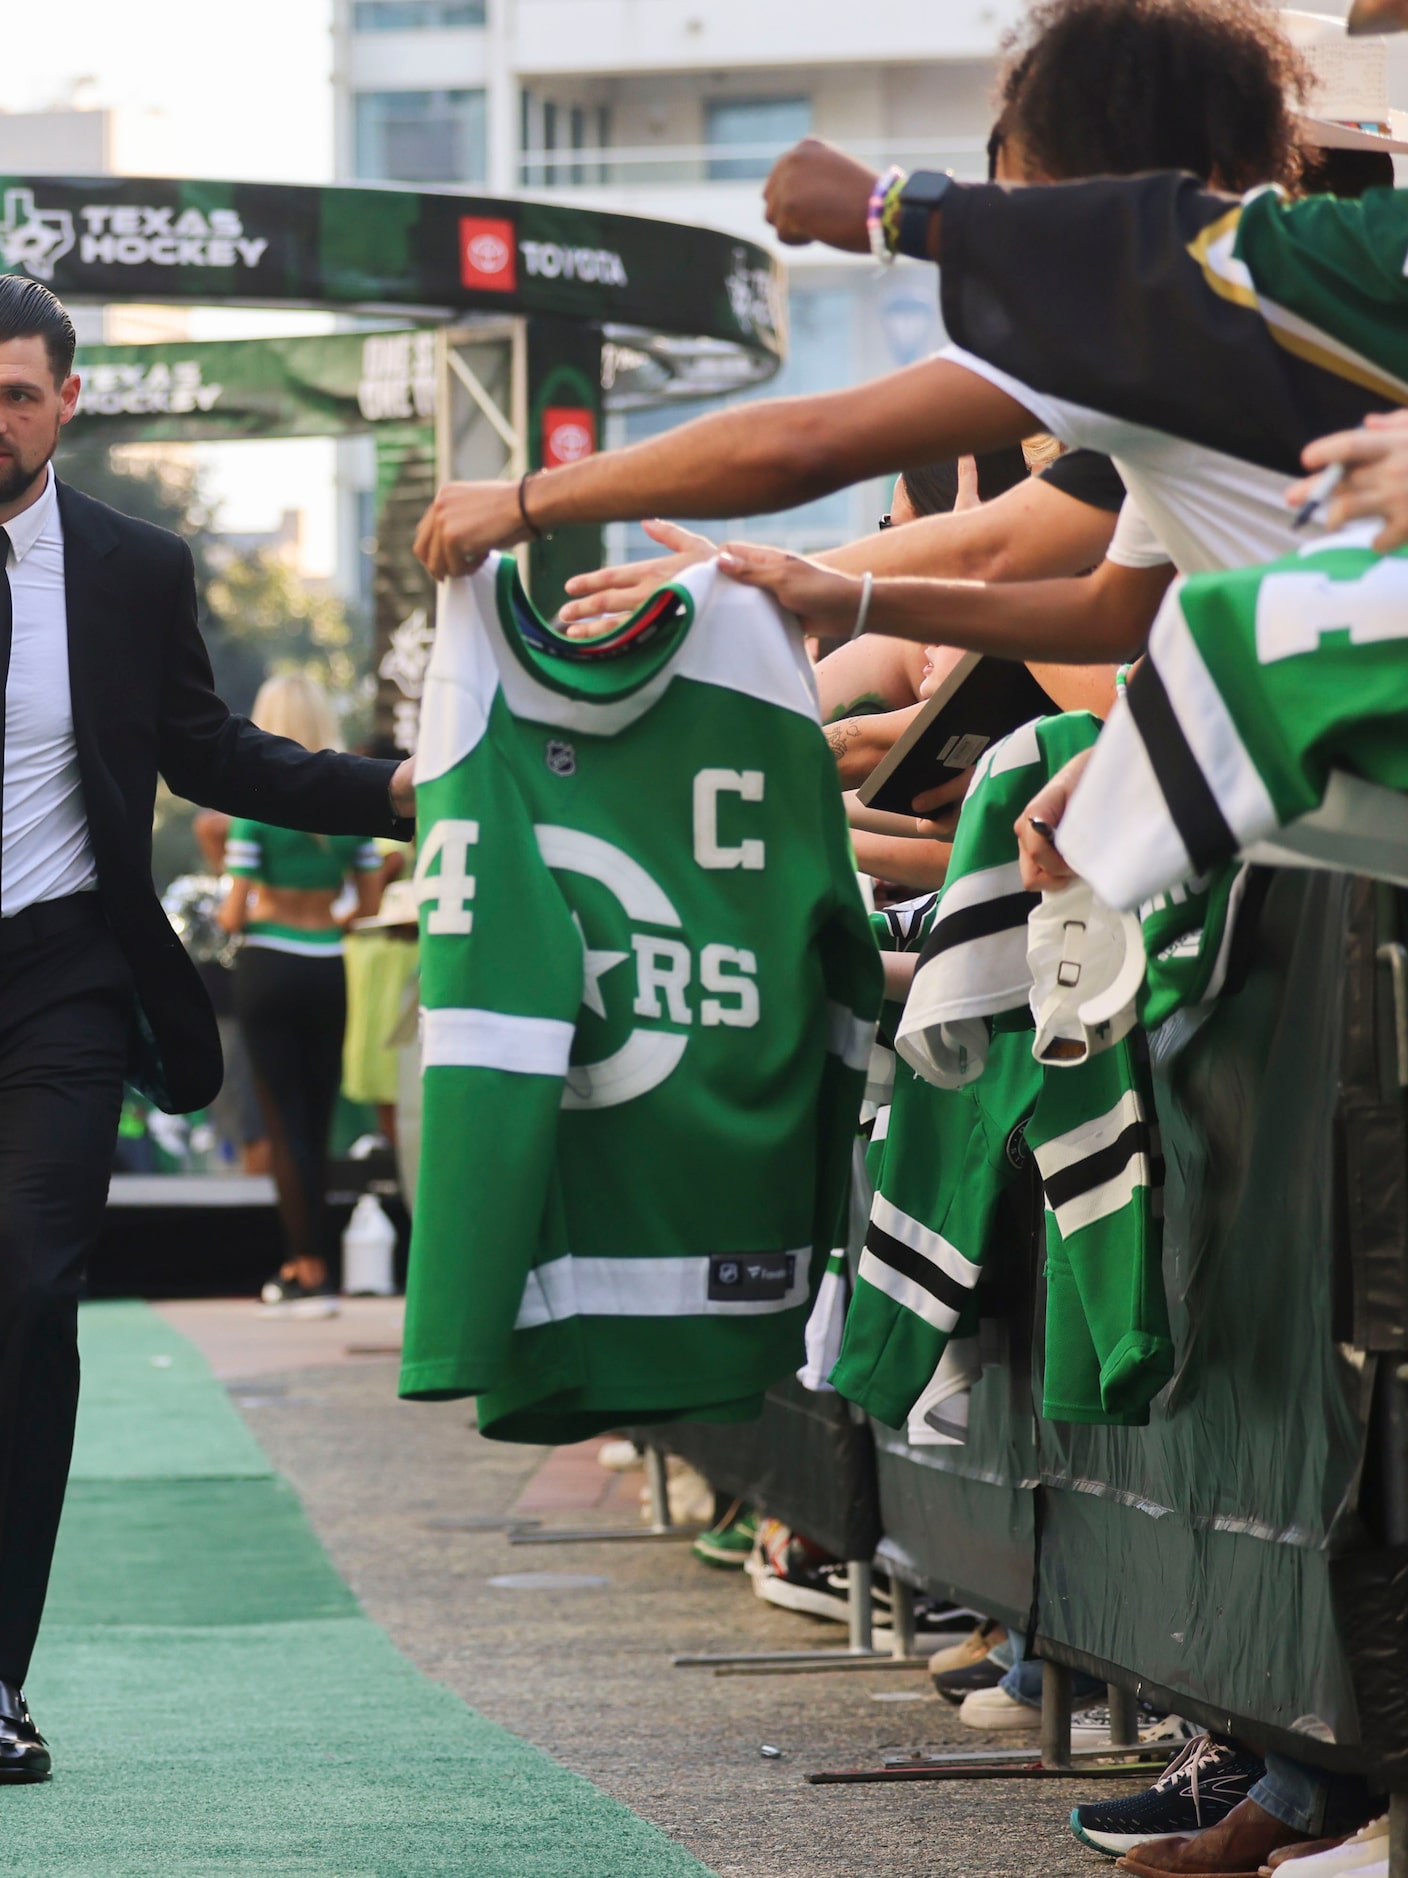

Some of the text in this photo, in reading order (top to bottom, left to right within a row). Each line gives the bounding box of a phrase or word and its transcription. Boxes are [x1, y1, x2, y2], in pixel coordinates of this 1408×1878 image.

[80, 205, 243, 238] TEXAS
[80, 236, 268, 267] HOCKEY
[519, 241, 628, 287] TOYOTA
[74, 360, 202, 391] TEXAS
[693, 768, 766, 870] C
